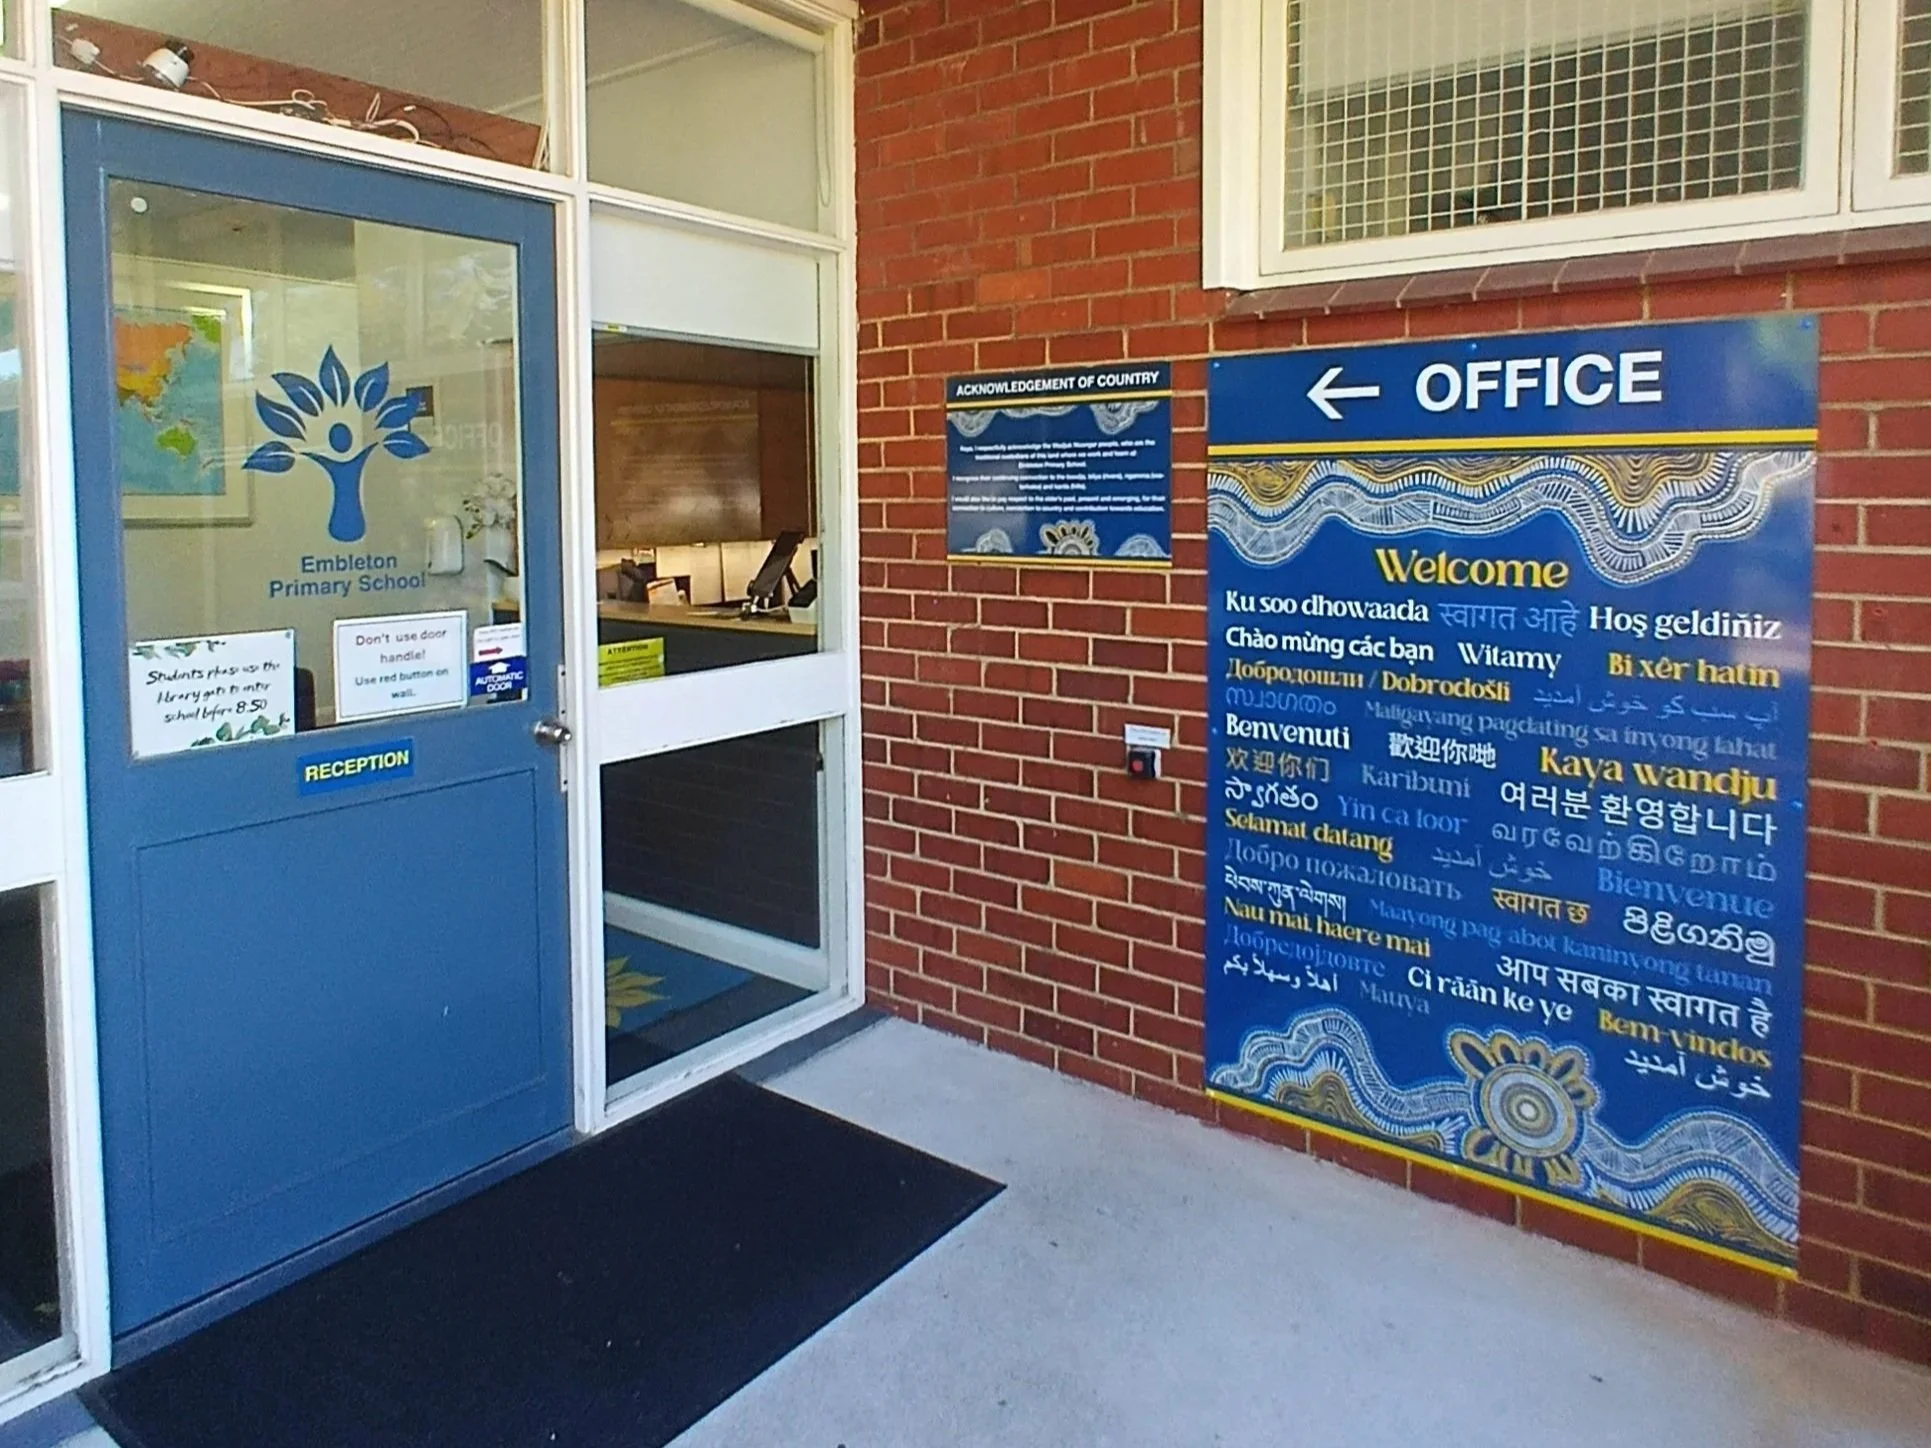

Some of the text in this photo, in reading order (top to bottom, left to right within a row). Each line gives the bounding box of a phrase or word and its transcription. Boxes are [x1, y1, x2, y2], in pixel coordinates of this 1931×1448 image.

[956, 370, 1160, 397] ACKNOWLEDGEMENT OF COUNTRY
[1415, 350, 1663, 413] OFFICE
[301, 555, 397, 573] Embleton
[1375, 548, 1570, 588] Welcome
[269, 572, 426, 598] Primary School
[1226, 590, 1430, 623] Ku soo dhowaada
[1437, 599, 1581, 638] स्वागत आहे
[1589, 606, 1648, 638] Hoş
[355, 629, 447, 646] Don't use door
[1226, 626, 1434, 666] Chào mừng các bạn
[380, 650, 426, 664] handle!
[1458, 642, 1562, 679] Witamy
[1608, 652, 1781, 689] Bi xêr hatin
[146, 668, 205, 686] Students
[354, 668, 448, 686] Use red button on
[475, 671, 524, 687] AUTOMATIC
[486, 681, 513, 693] DOOR
[1226, 657, 1364, 690] Добродошли
[1382, 671, 1511, 702] Dobrodošli
[164, 706, 199, 723] school
[202, 703, 232, 723] before
[1226, 713, 1350, 750] Benvenuti
[1365, 700, 1473, 735] Maligayang
[1477, 713, 1588, 749] pagdating
[1593, 727, 1619, 744] sa
[1624, 729, 1708, 761] inyong
[304, 750, 410, 783] RECEPTION
[1360, 765, 1471, 798] Karibuni
[1540, 746, 1777, 806] Kaya wandju
[1337, 795, 1469, 834] Yin ca loor
[1501, 780, 1779, 846] 여러분 환영합니다
[1225, 807, 1395, 863] Selamat datang
[1224, 838, 1463, 901] Добро пожаловать
[1491, 887, 1562, 920] स्वागत
[1597, 867, 1775, 920] Bienvenue
[1224, 896, 1265, 921] Nau
[1317, 916, 1381, 946] haere
[1386, 933, 1431, 959] mai
[1224, 923, 1387, 978] Добредојдовте
[1370, 898, 1457, 940] Maayong
[1563, 935, 1690, 987] kaninyong
[1696, 963, 1773, 996] tanan
[1359, 980, 1430, 1017] Mauya
[1407, 965, 1432, 991] Ci
[1503, 986, 1535, 1013] ke
[1538, 998, 1574, 1027] ye
[1495, 955, 1774, 1039] आप सबका स्वागत है
[1598, 1007, 1773, 1069] Bem-vindos
[1693, 1063, 1772, 1099] خوش
